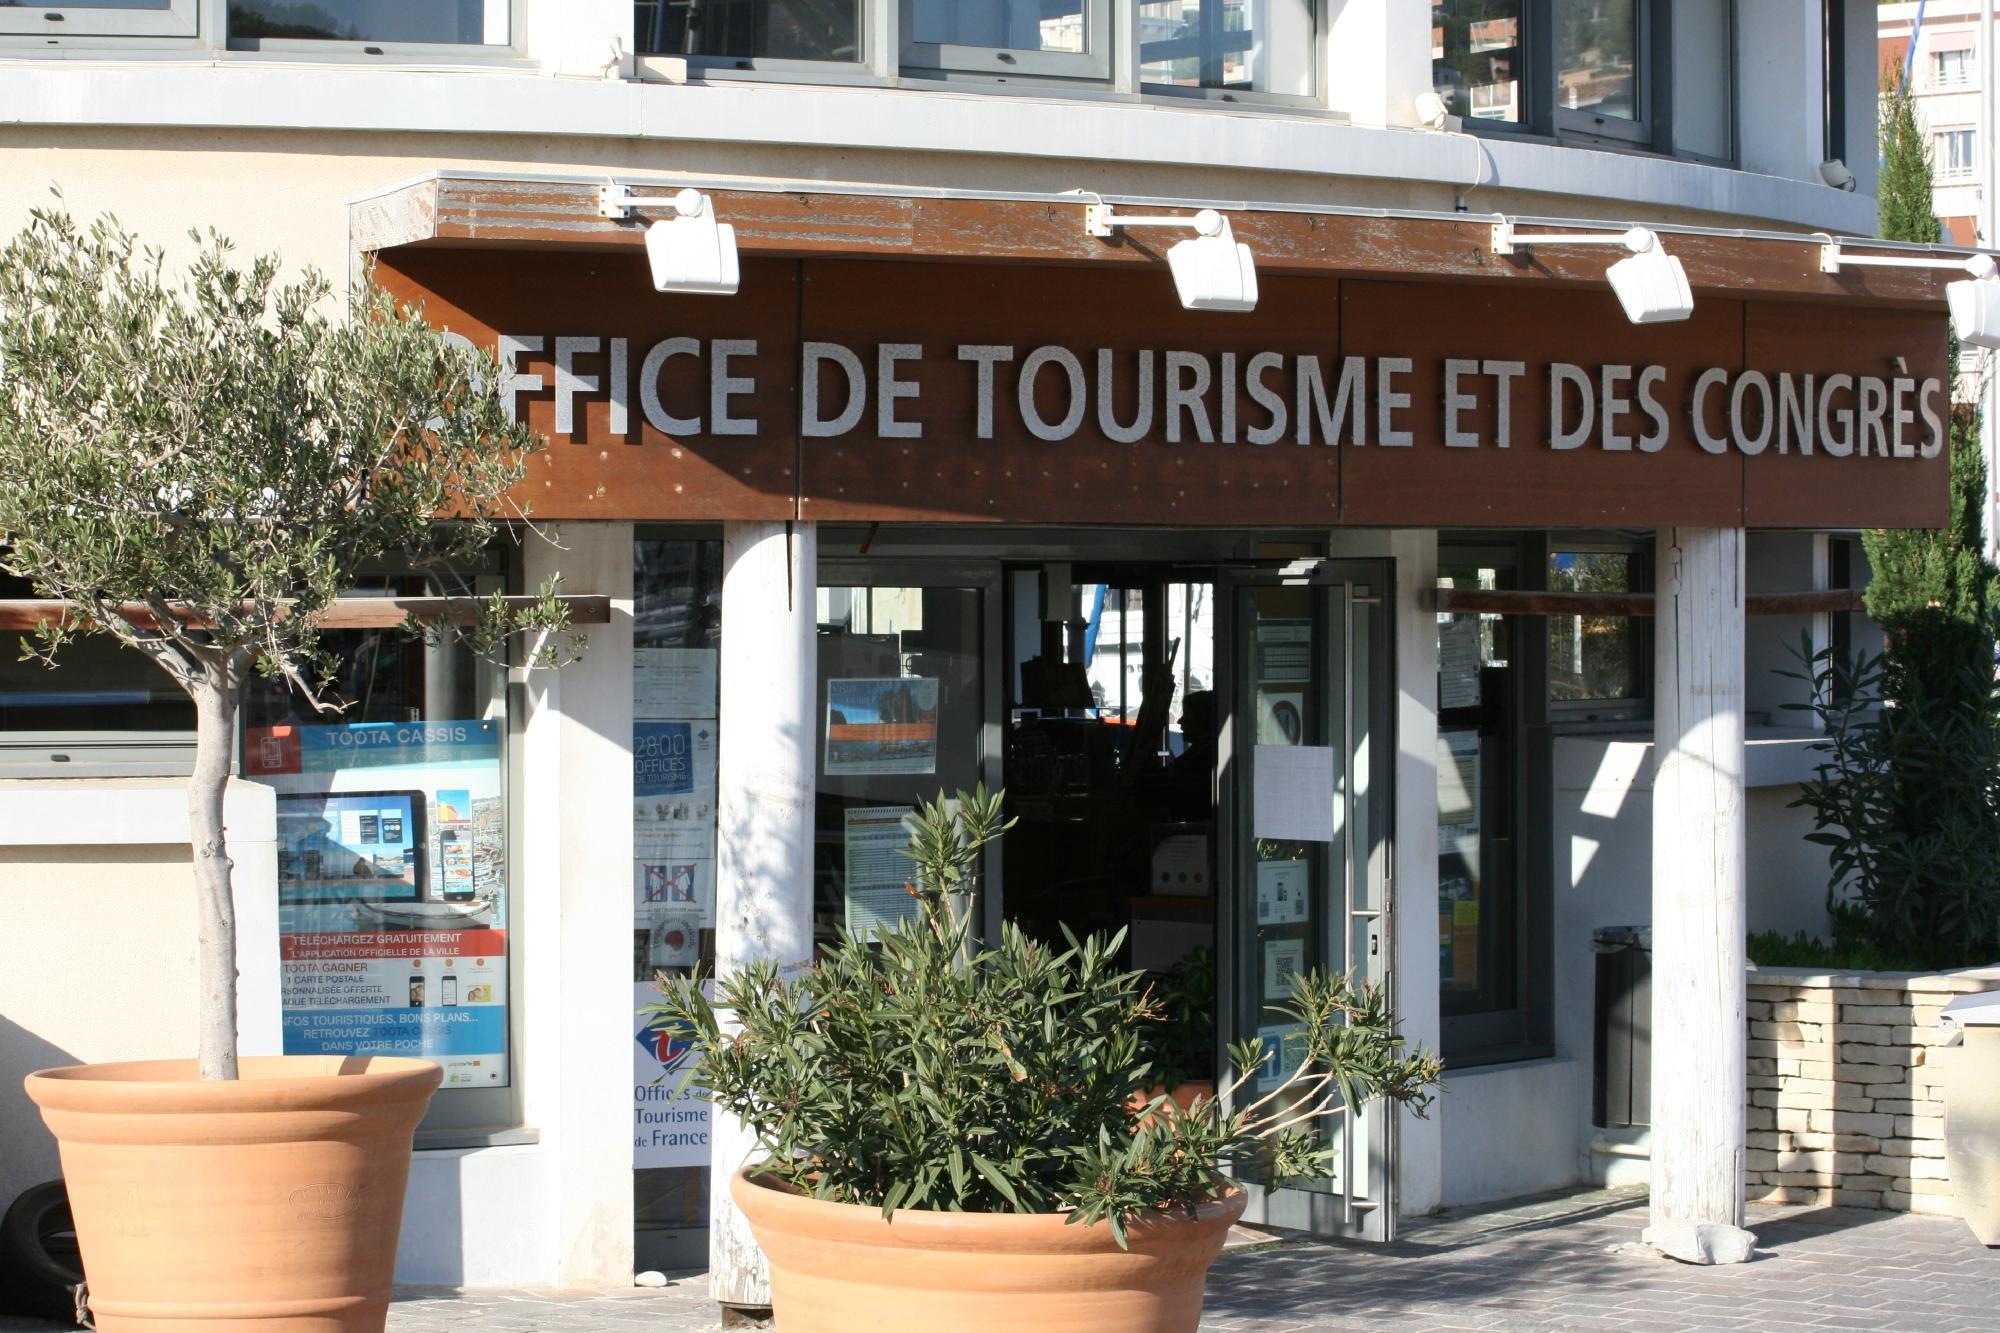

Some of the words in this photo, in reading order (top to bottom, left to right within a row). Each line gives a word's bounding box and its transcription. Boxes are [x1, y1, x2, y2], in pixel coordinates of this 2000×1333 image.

[410, 331, 758, 437] FFICE
[802, 340, 923, 439] DE
[957, 343, 1413, 447] TOURISME
[1444, 357, 1526, 448] ET
[1550, 362, 1671, 453] DES
[1692, 355, 1942, 460] CONGRÈS
[327, 729, 392, 746] TOOTA
[397, 727, 468, 744] CASSIS
[635, 757, 687, 774] OFFICES
[636, 774, 646, 784] DE
[647, 772, 688, 783] TOURISME
[293, 934, 374, 946] TÉLÉCHARGEZ
[377, 933, 462, 944] GRATUITEMENT
[292, 948, 356, 959] L'APPLICATION
[359, 948, 408, 957] OFFICIELLE
[410, 948, 421, 956] DE
[436, 947, 460, 955] VILLE
[284, 963, 319, 974] TOOTA
[322, 962, 368, 972] GAGNER
[295, 975, 324, 985] CARTE
[326, 974, 365, 984] POSTALE
[344, 985, 383, 994] OFFERTE
[312, 1014, 397, 1026] TOURISTIQUES,
[400, 1013, 431, 1024] BONS
[304, 1028, 370, 1039] RETROUVEZ
[373, 1026, 410, 1037] TOOTA
[322, 1041, 352, 1051] DANS
[355, 1040, 391, 1050] VOTRE
[395, 1039, 434, 1049] POCHE
[635, 1085, 690, 1102] Offics
[635, 1107, 708, 1125] Tourisme
[634, 1136, 648, 1148] de
[652, 1129, 708, 1147] France
